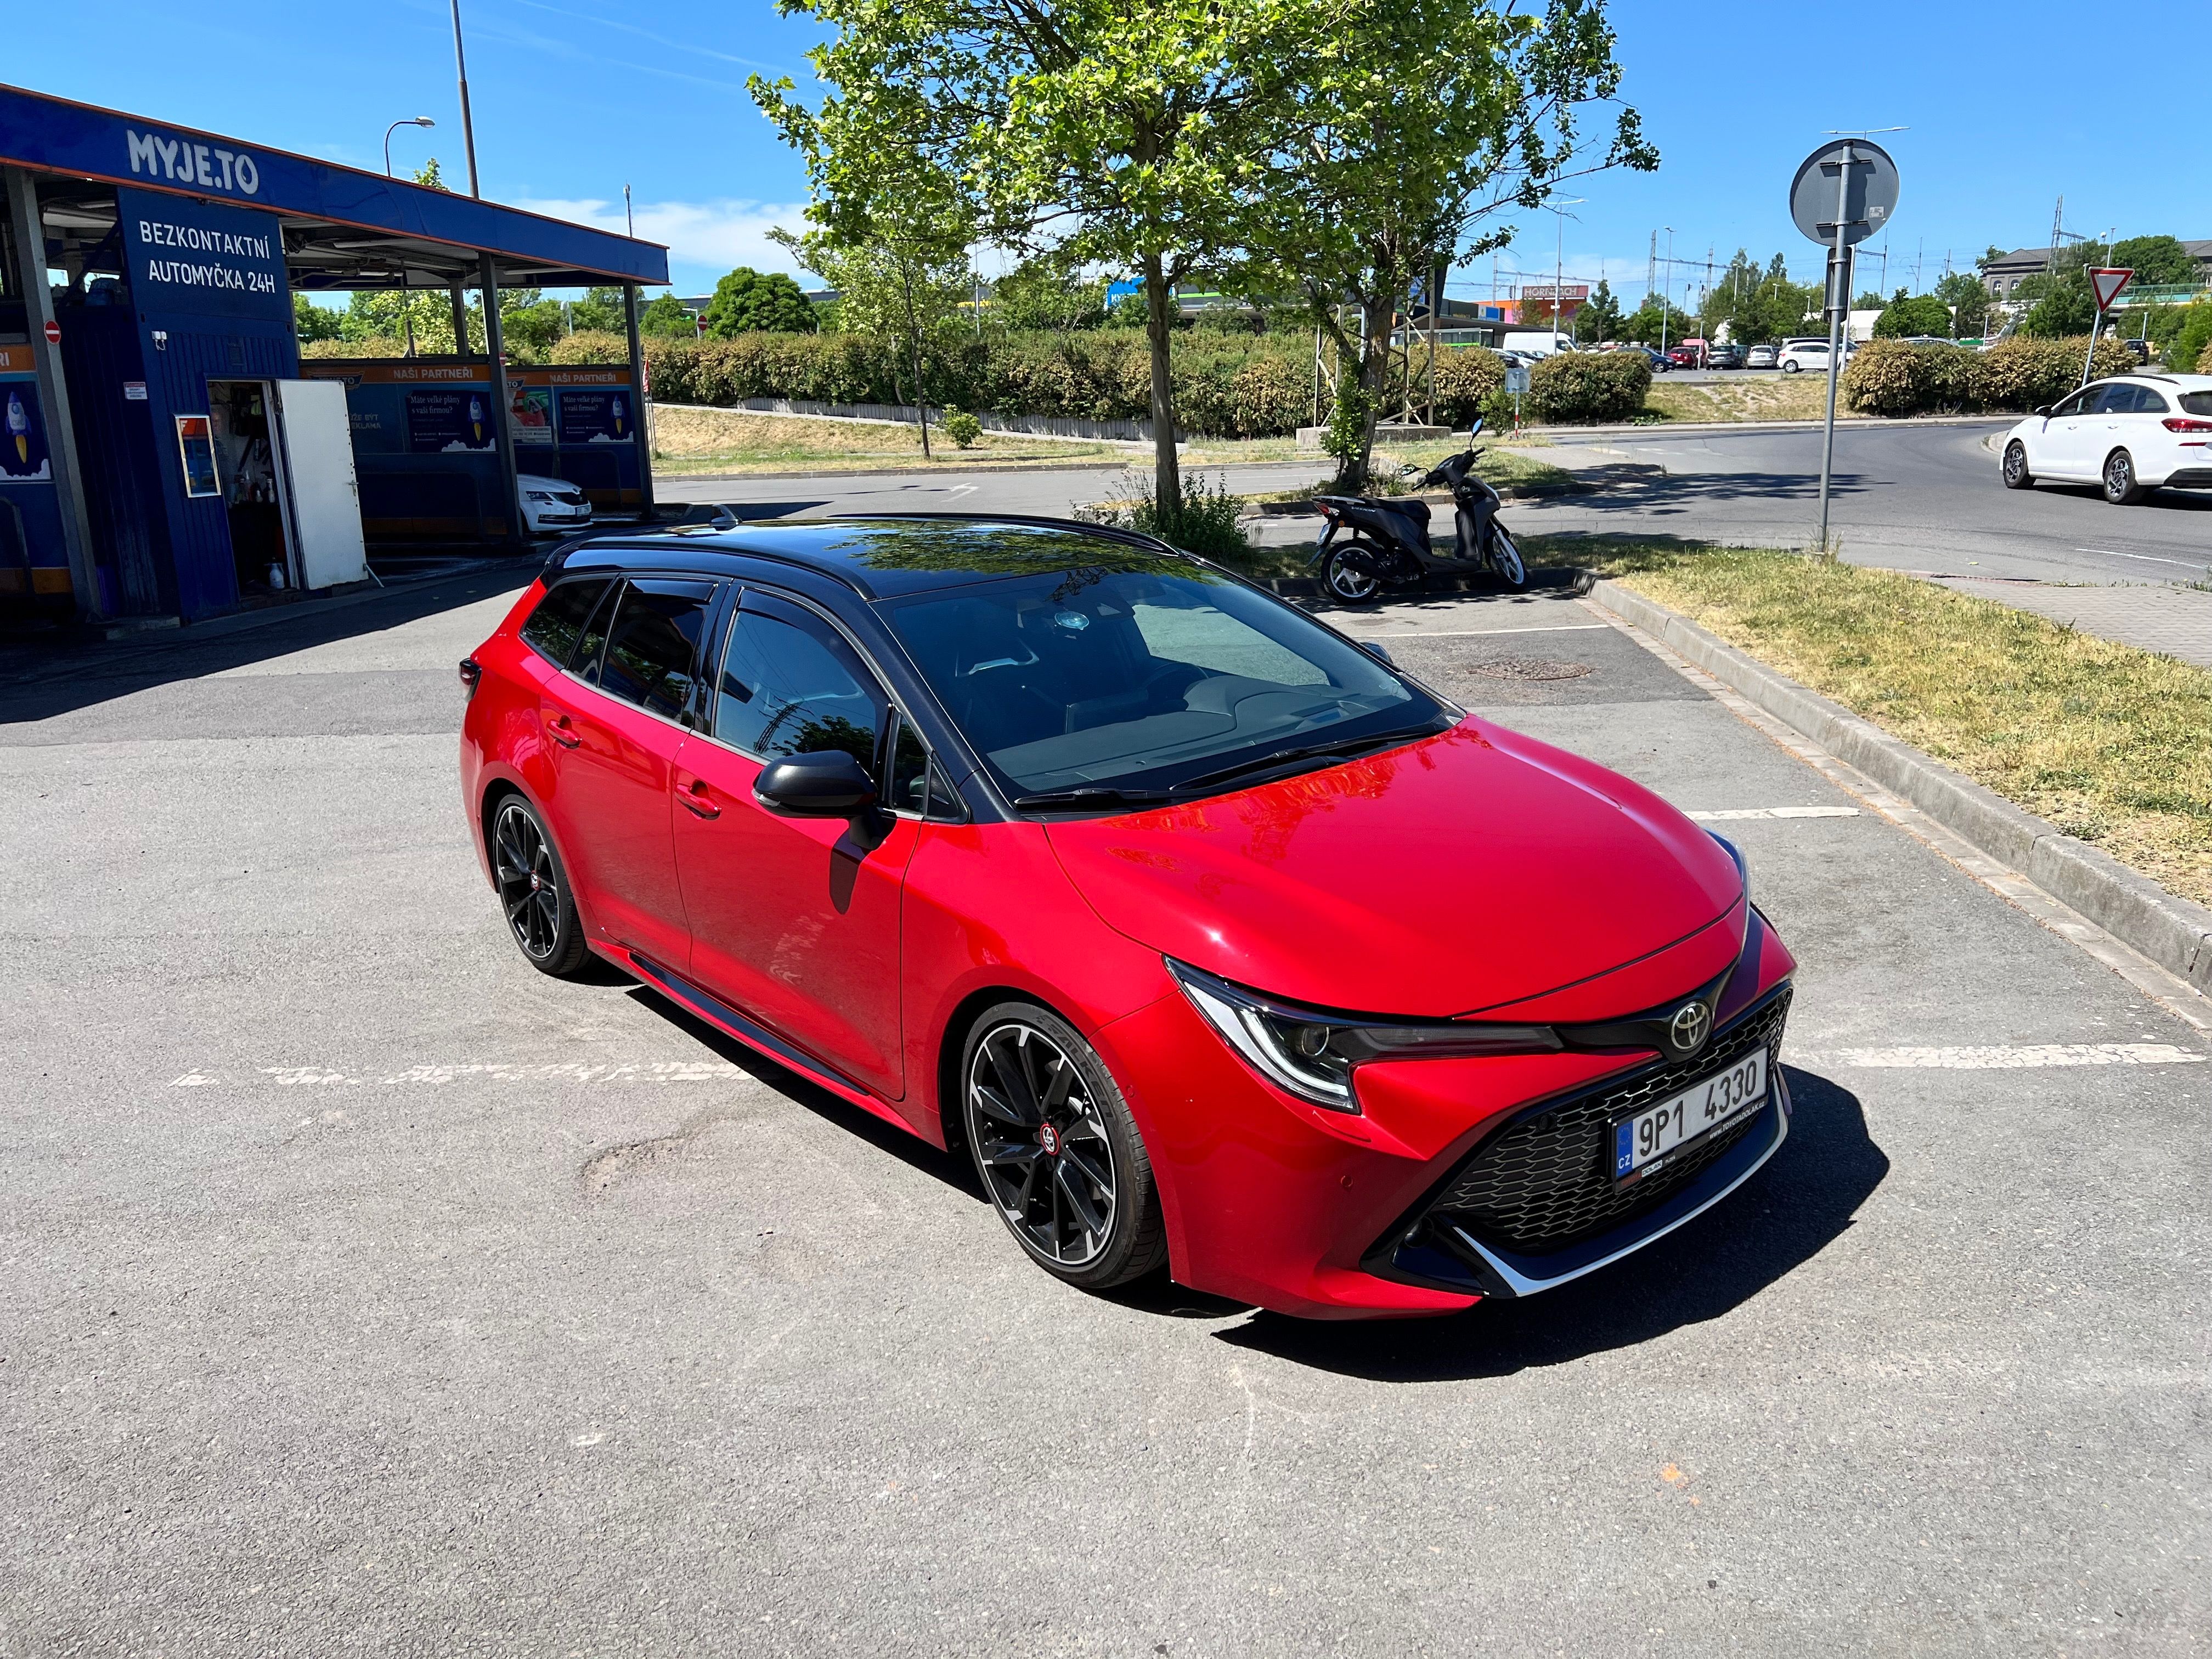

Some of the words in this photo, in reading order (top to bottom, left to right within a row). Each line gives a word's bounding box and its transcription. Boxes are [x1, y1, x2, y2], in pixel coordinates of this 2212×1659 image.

[127, 129, 258, 195] MYJE.TO
[139, 220, 270, 259] BEZKONTAKTNÍ
[149, 259, 244, 290] AUTOMYČKA
[249, 273, 275, 293] 24H
[394, 367, 419, 379] NAŠI
[421, 366, 473, 379] PARTNEŘI
[549, 373, 571, 383] NAŠI
[573, 373, 617, 382] PARTNEŘI
[410, 395, 426, 404] Máte
[443, 395, 460, 405] plány
[591, 395, 605, 404] plány
[429, 405, 453, 414] firmou?
[351, 422, 382, 430] EKLAMA
[1639, 1101, 1684, 1158] 9P1
[1705, 1060, 1757, 1120] 4330
[1618, 1153, 1631, 1170] CZ
